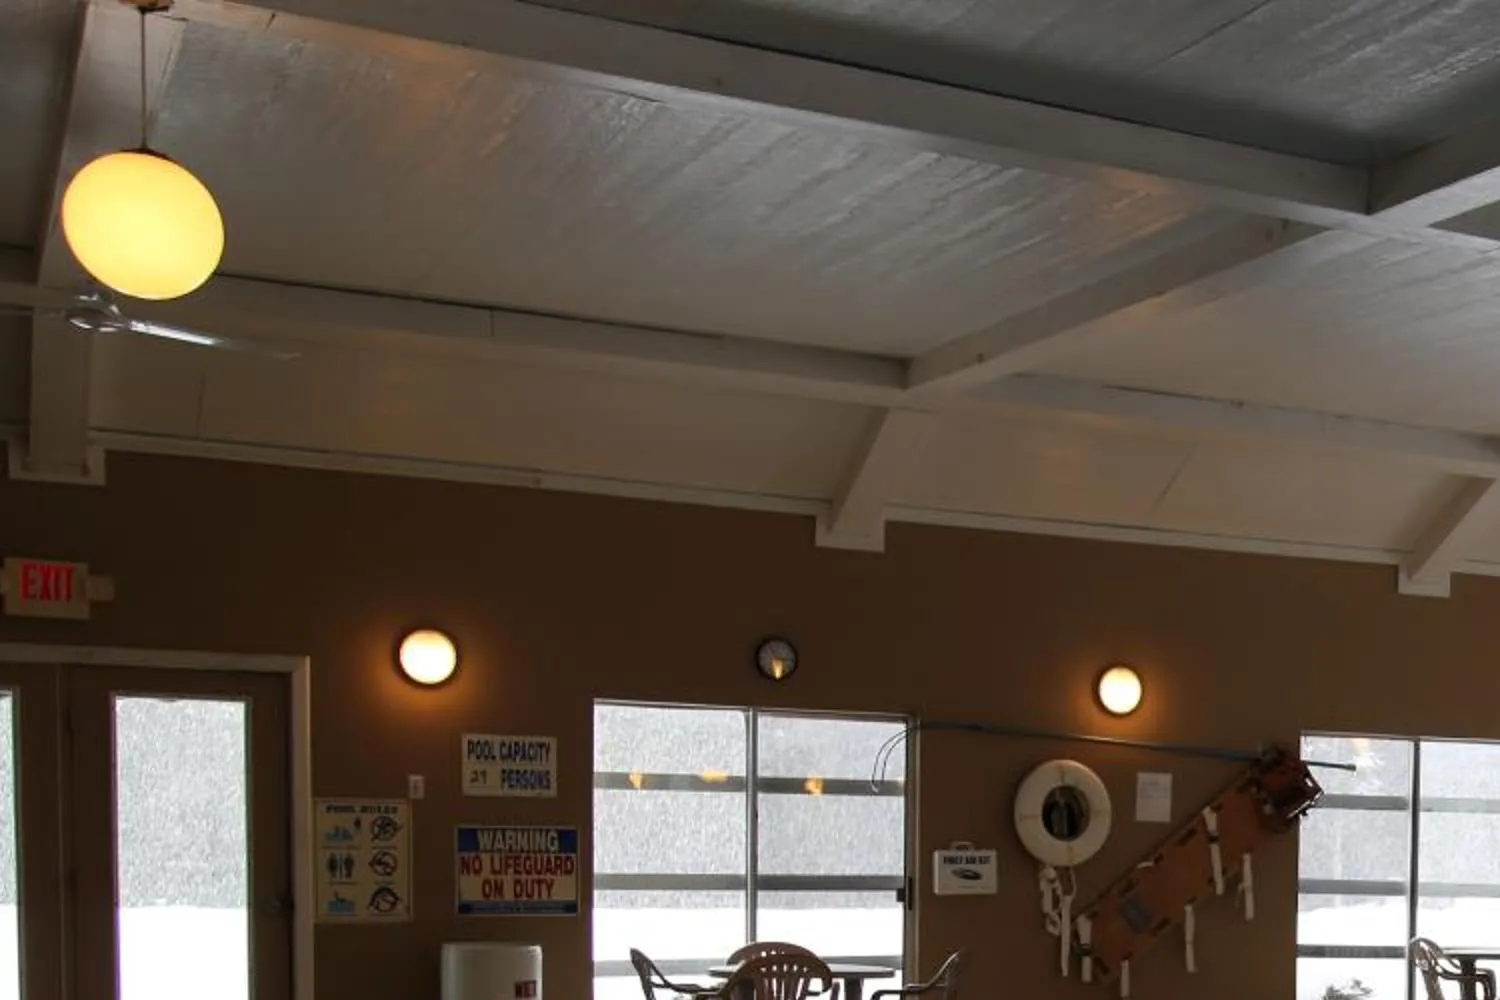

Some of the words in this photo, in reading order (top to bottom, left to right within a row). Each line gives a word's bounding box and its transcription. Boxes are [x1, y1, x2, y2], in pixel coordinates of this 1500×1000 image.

[21, 562, 76, 602] EXIT
[467, 739, 496, 761] POOL
[500, 740, 551, 764] CAPACITY
[501, 768, 551, 790] PERSONS
[478, 828, 560, 853] WARNING
[460, 855, 483, 876] NO
[490, 855, 575, 876] LIFEGUARD
[482, 879, 504, 898] ON
[514, 879, 554, 899] DUTY
